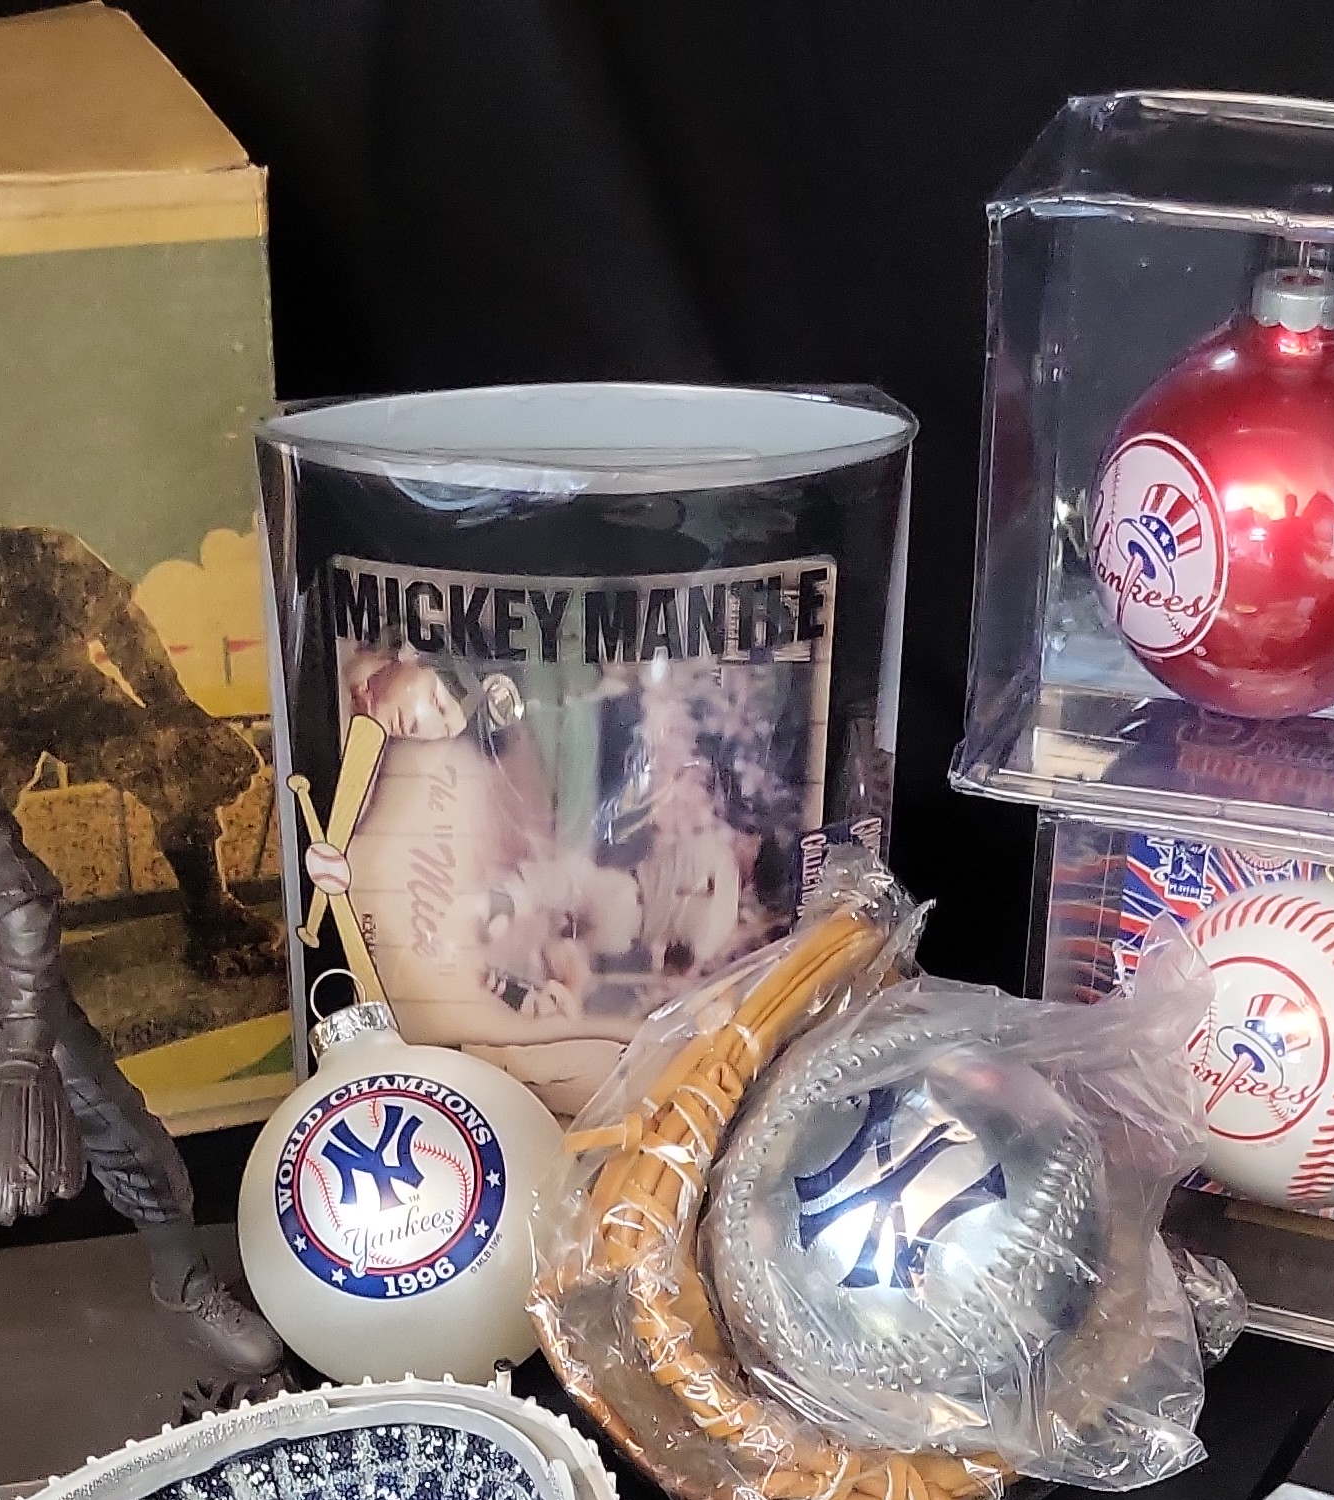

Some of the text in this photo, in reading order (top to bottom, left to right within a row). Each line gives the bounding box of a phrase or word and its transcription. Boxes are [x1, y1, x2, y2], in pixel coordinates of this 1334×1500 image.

[333, 567, 829, 665] MICKEY MANTLE
[277, 1075, 494, 1214] WORLD CHAMPIONS
[343, 1207, 456, 1279] Yankees
[383, 1256, 457, 1298] 1996
